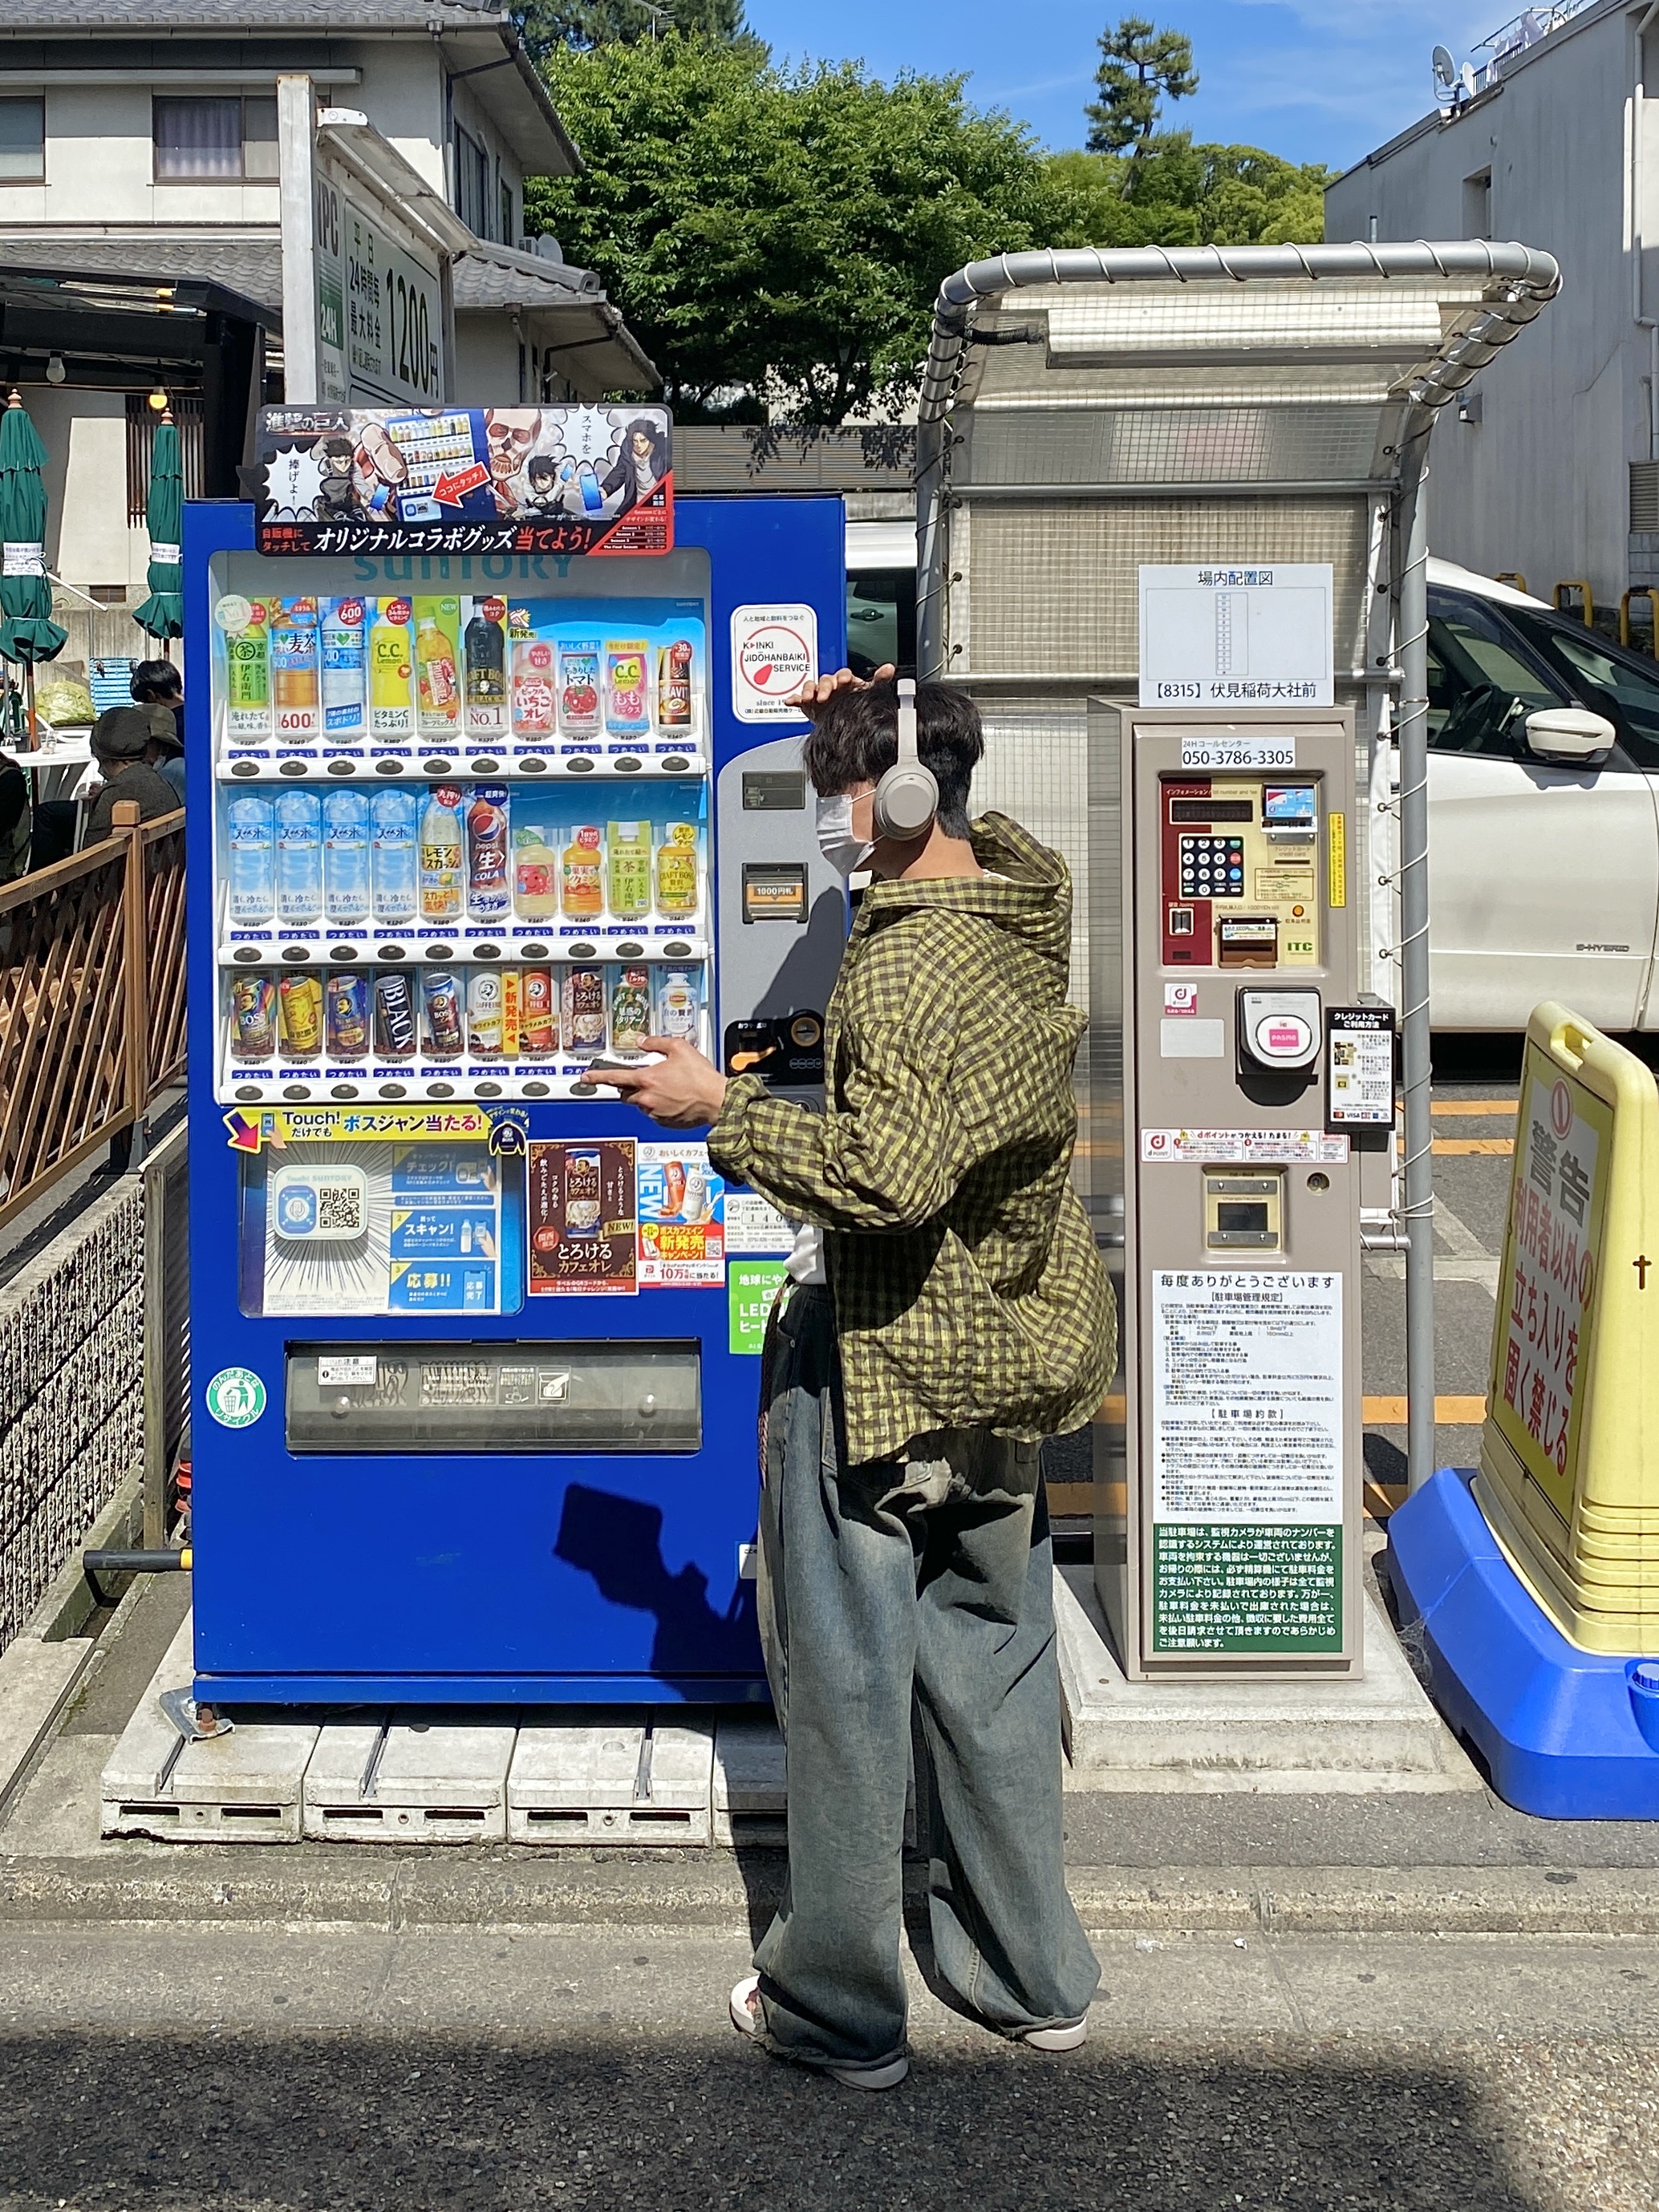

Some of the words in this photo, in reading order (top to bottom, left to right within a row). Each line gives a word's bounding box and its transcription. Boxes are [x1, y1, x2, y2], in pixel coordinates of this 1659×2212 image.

[353, 221, 374, 265] 平日
[321, 303, 338, 343] 24H
[351, 301, 381, 350] 最大料金
[387, 267, 439, 399] 1200円
[266, 411, 351, 431] 進撃の巨人
[582, 415, 592, 455] スマホを
[262, 528, 304, 540] 自販機に
[313, 525, 592, 553] オリジナルコラボグッズ当てよう!
[262, 541, 311, 553] タッチして
[1198, 570, 1273, 586] 場内配置図
[440, 603, 457, 611] NEW
[340, 607, 362, 620] 600
[290, 633, 316, 654] 麦茶
[560, 641, 600, 651] おいしく野菜!
[378, 643, 404, 658] C.C.
[533, 657, 547, 666] 甘さ
[773, 663, 810, 672] SERVICE
[563, 666, 596, 675] すっきりした
[615, 665, 640, 679] C.C.
[241, 663, 252, 700] 伊右衛門
[566, 674, 594, 685] トマト
[1156, 683, 1202, 699] 【8315】
[1210, 682, 1316, 699] 伏見稲荷大社前
[517, 696, 551, 708] いちご
[615, 691, 640, 706] もも
[374, 710, 408, 719] ビタミンC
[523, 708, 545, 719] オレ
[615, 706, 641, 715] ミックス
[374, 719, 409, 727] たっぷり!
[1182, 750, 1294, 765] 050-3786-3305
[485, 790, 507, 798] 超爽快!
[425, 847, 452, 858] レモン
[475, 842, 499, 851] pepsi
[426, 859, 459, 869] スカッシュ
[623, 861, 635, 873] 茶
[474, 871, 500, 881] COLA
[424, 889, 453, 901] スカッと!
[624, 877, 634, 907] 伊右衛門
[756, 887, 794, 897] 1000円札
[424, 900, 448, 910] 爽快!
[515, 929, 550, 937] つめたい
[1287, 942, 1313, 952] ITC
[575, 991, 602, 1001] とろける
[383, 983, 415, 1049] BLACK
[434, 1010, 453, 1019] BOSS
[505, 991, 517, 1031] 新発売
[1334, 1012, 1389, 1021] クレジットカード
[240, 1011, 266, 1026] BOSS
[1343, 1020, 1380, 1029] ご利用方法
[282, 1111, 340, 1125] Touch!
[343, 1114, 483, 1132] ボスジャン当たる!
[291, 1126, 333, 1137] だけでも
[1269, 1132, 1292, 1140] たまる!
[406, 1161, 452, 1173] チェック!
[1529, 1120, 1591, 1230] 警告
[569, 1177, 598, 1187] とろける
[570, 1187, 596, 1195] カフェオレ
[617, 1166, 625, 1217] とろけるような
[639, 1164, 663, 1219] NEW
[405, 1223, 454, 1236] スキャン!
[607, 1221, 634, 1233] NEW!
[659, 1226, 704, 1235] ボスカフェイン
[537, 1232, 554, 1242] 関西
[659, 1235, 705, 1251] 新発売
[1513, 1175, 1595, 1314] 利用者以外の
[558, 1243, 612, 1260] とろける
[660, 1251, 704, 1260] キャンペーン!
[558, 1260, 612, 1274] カフェオレ
[407, 1273, 451, 1289] 応募!!
[466, 1281, 484, 1290] 応募
[1160, 1274, 1335, 1289] 毎度ありがとうございます
[466, 1290, 483, 1300] 完了
[1511, 1260, 1580, 1398] 立ち入りを
[212, 1369, 260, 1392] のんだあとは
[1503, 1336, 1571, 1477] 固く禁じる
[214, 1408, 259, 1425] リサイクル
[1158, 1527, 1335, 1537] 当駐車場は、監視カメラが車両のナンバーを
[1158, 1540, 1337, 1550] 認識するシステムにより運営されております。
[1158, 1552, 1333, 1562] 車両を拘束する機器は一切ございませんが、
[1158, 1564, 1335, 1574] お帰りの際には、必ず精算機にて駐車料金を
[1158, 1577, 1335, 1587] お支払い下さい。駐車場内の様子は全て監視
[1158, 1589, 1335, 1599] カメラにより記録されております。万が一、
[1158, 1601, 1336, 1611] 駐車料金を未払いで出庫された場合は、
[1158, 1614, 1335, 1624] 未払い駐車料金の他、徴収に要した費用全て
[1158, 1626, 1337, 1636] を後日請求させて頂きますのであらかじめ
[1158, 1638, 1224, 1648] ご注意願います。
